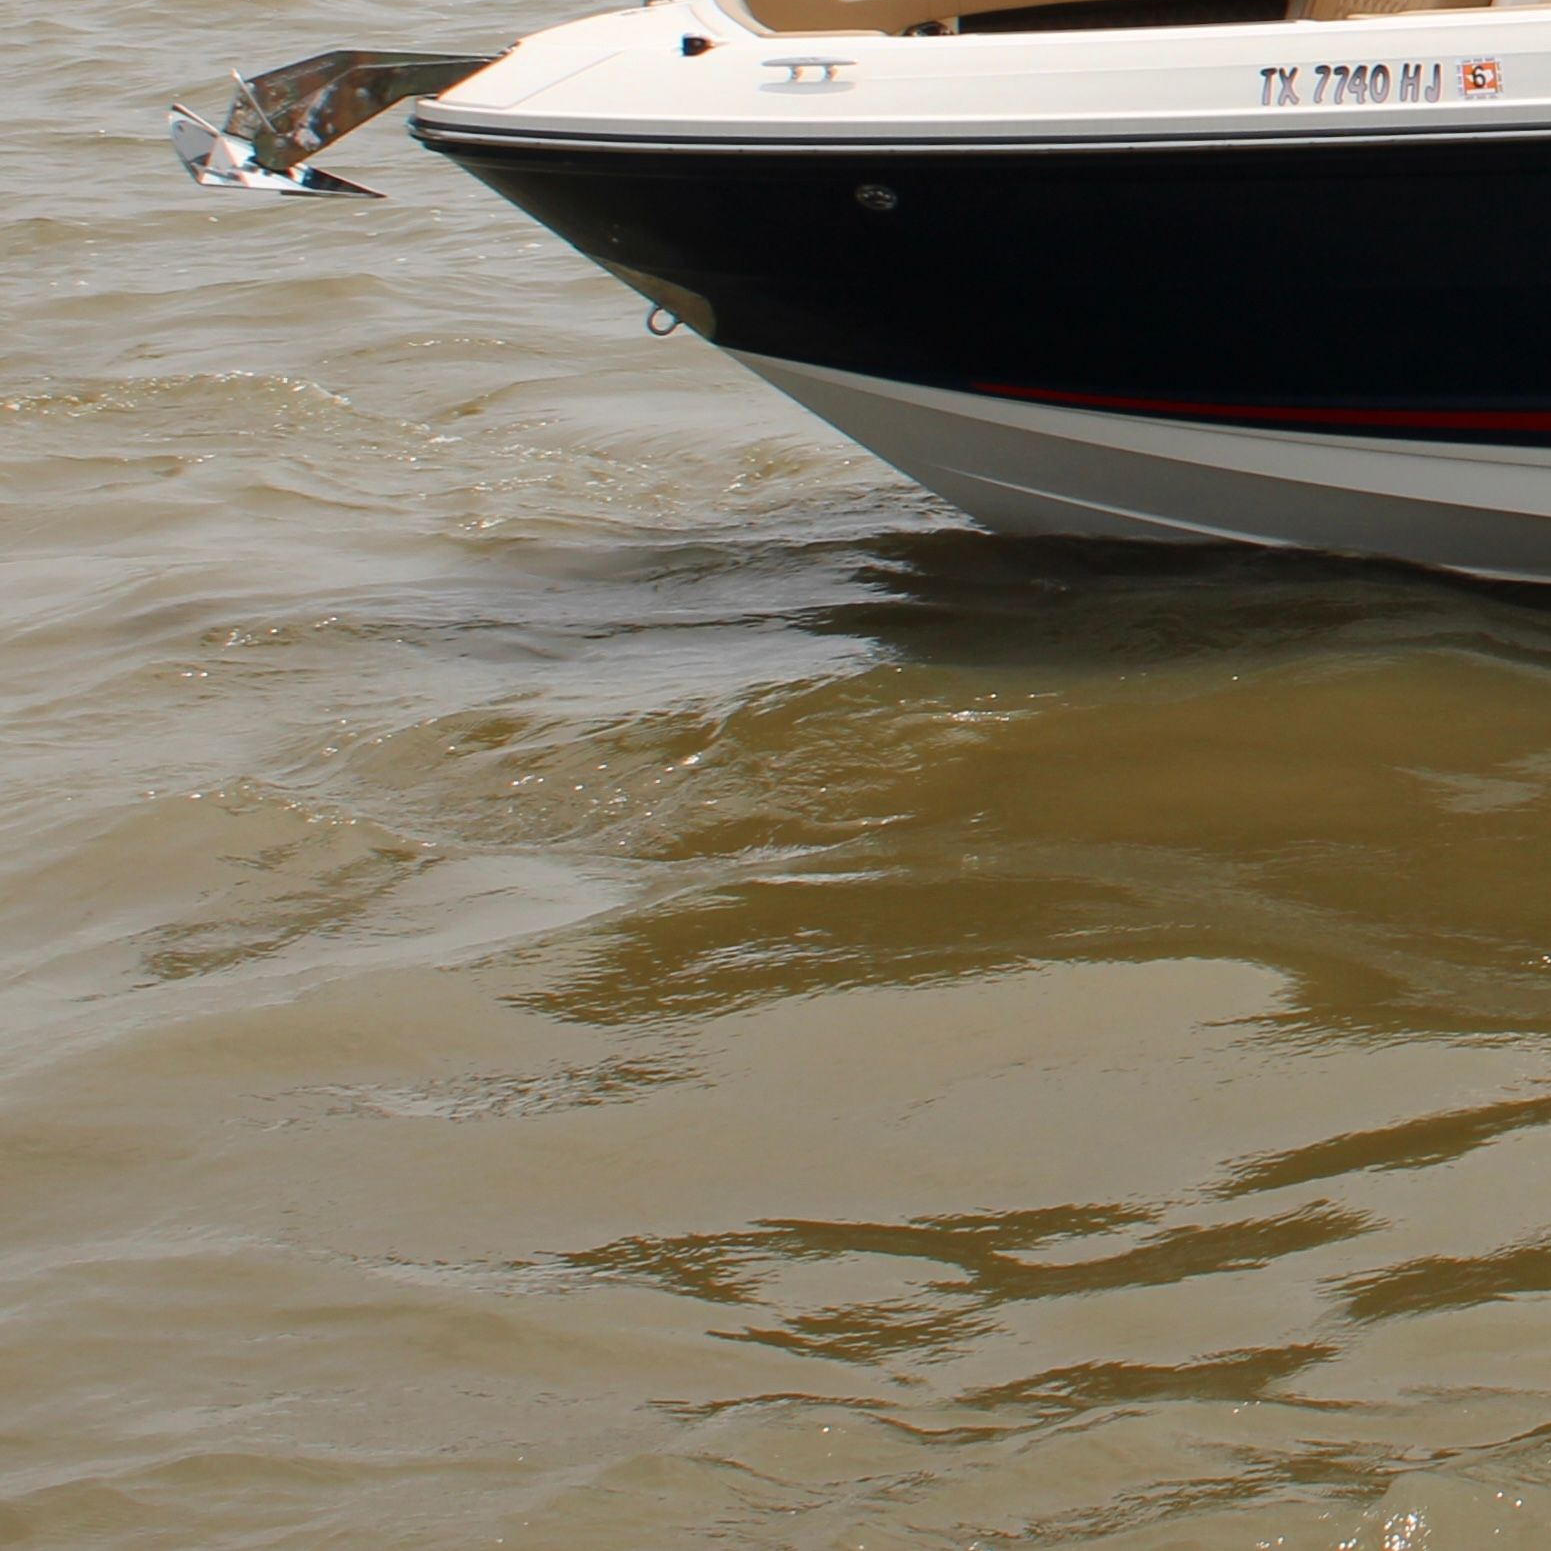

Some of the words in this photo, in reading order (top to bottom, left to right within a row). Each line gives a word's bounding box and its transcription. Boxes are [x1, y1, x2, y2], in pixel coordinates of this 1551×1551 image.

[1260, 67, 1300, 106] TX
[1314, 64, 1391, 105] 7740
[1400, 63, 1442, 103] HJ
[1471, 65, 1486, 87] 6
